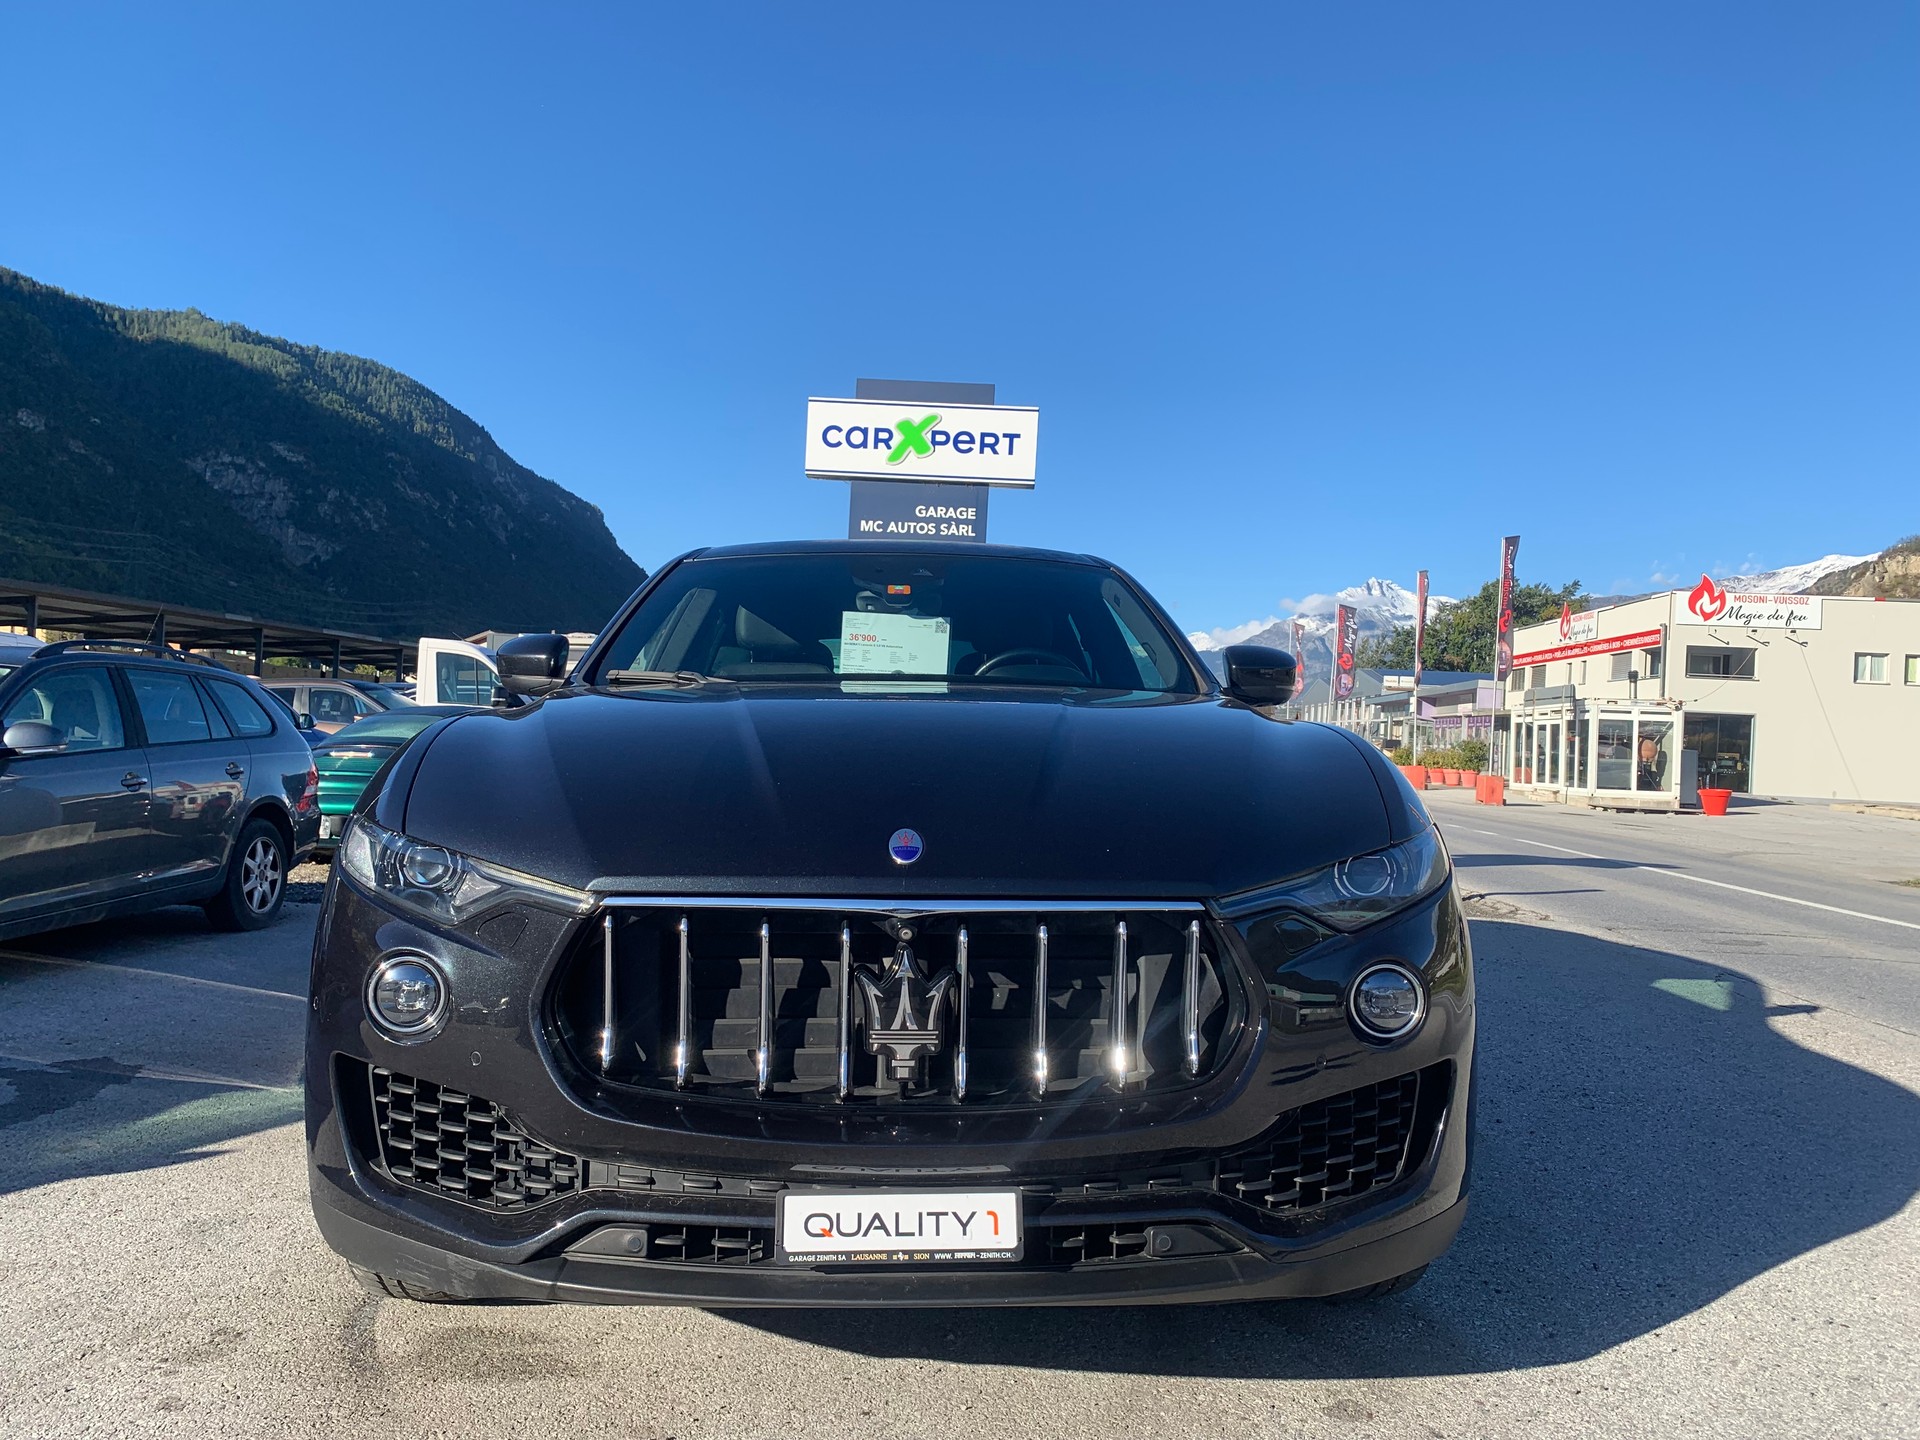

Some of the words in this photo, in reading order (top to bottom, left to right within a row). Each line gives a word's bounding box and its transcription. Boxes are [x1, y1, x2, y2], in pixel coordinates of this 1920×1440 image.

[915, 505, 977, 520] GARAGE
[860, 520, 884, 533] MC
[886, 521, 936, 535] AUTOS
[1733, 594, 1810, 606] MOSONI-VUISSOZ
[1717, 605, 1765, 626] Magie
[1767, 608, 1785, 621] du
[1785, 610, 1809, 627] feu
[803, 1211, 978, 1239] QUALITY
[986, 1210, 999, 1236] 1
[816, 1254, 837, 1262] ZENITH
[851, 1253, 888, 1261] LAUSANNE
